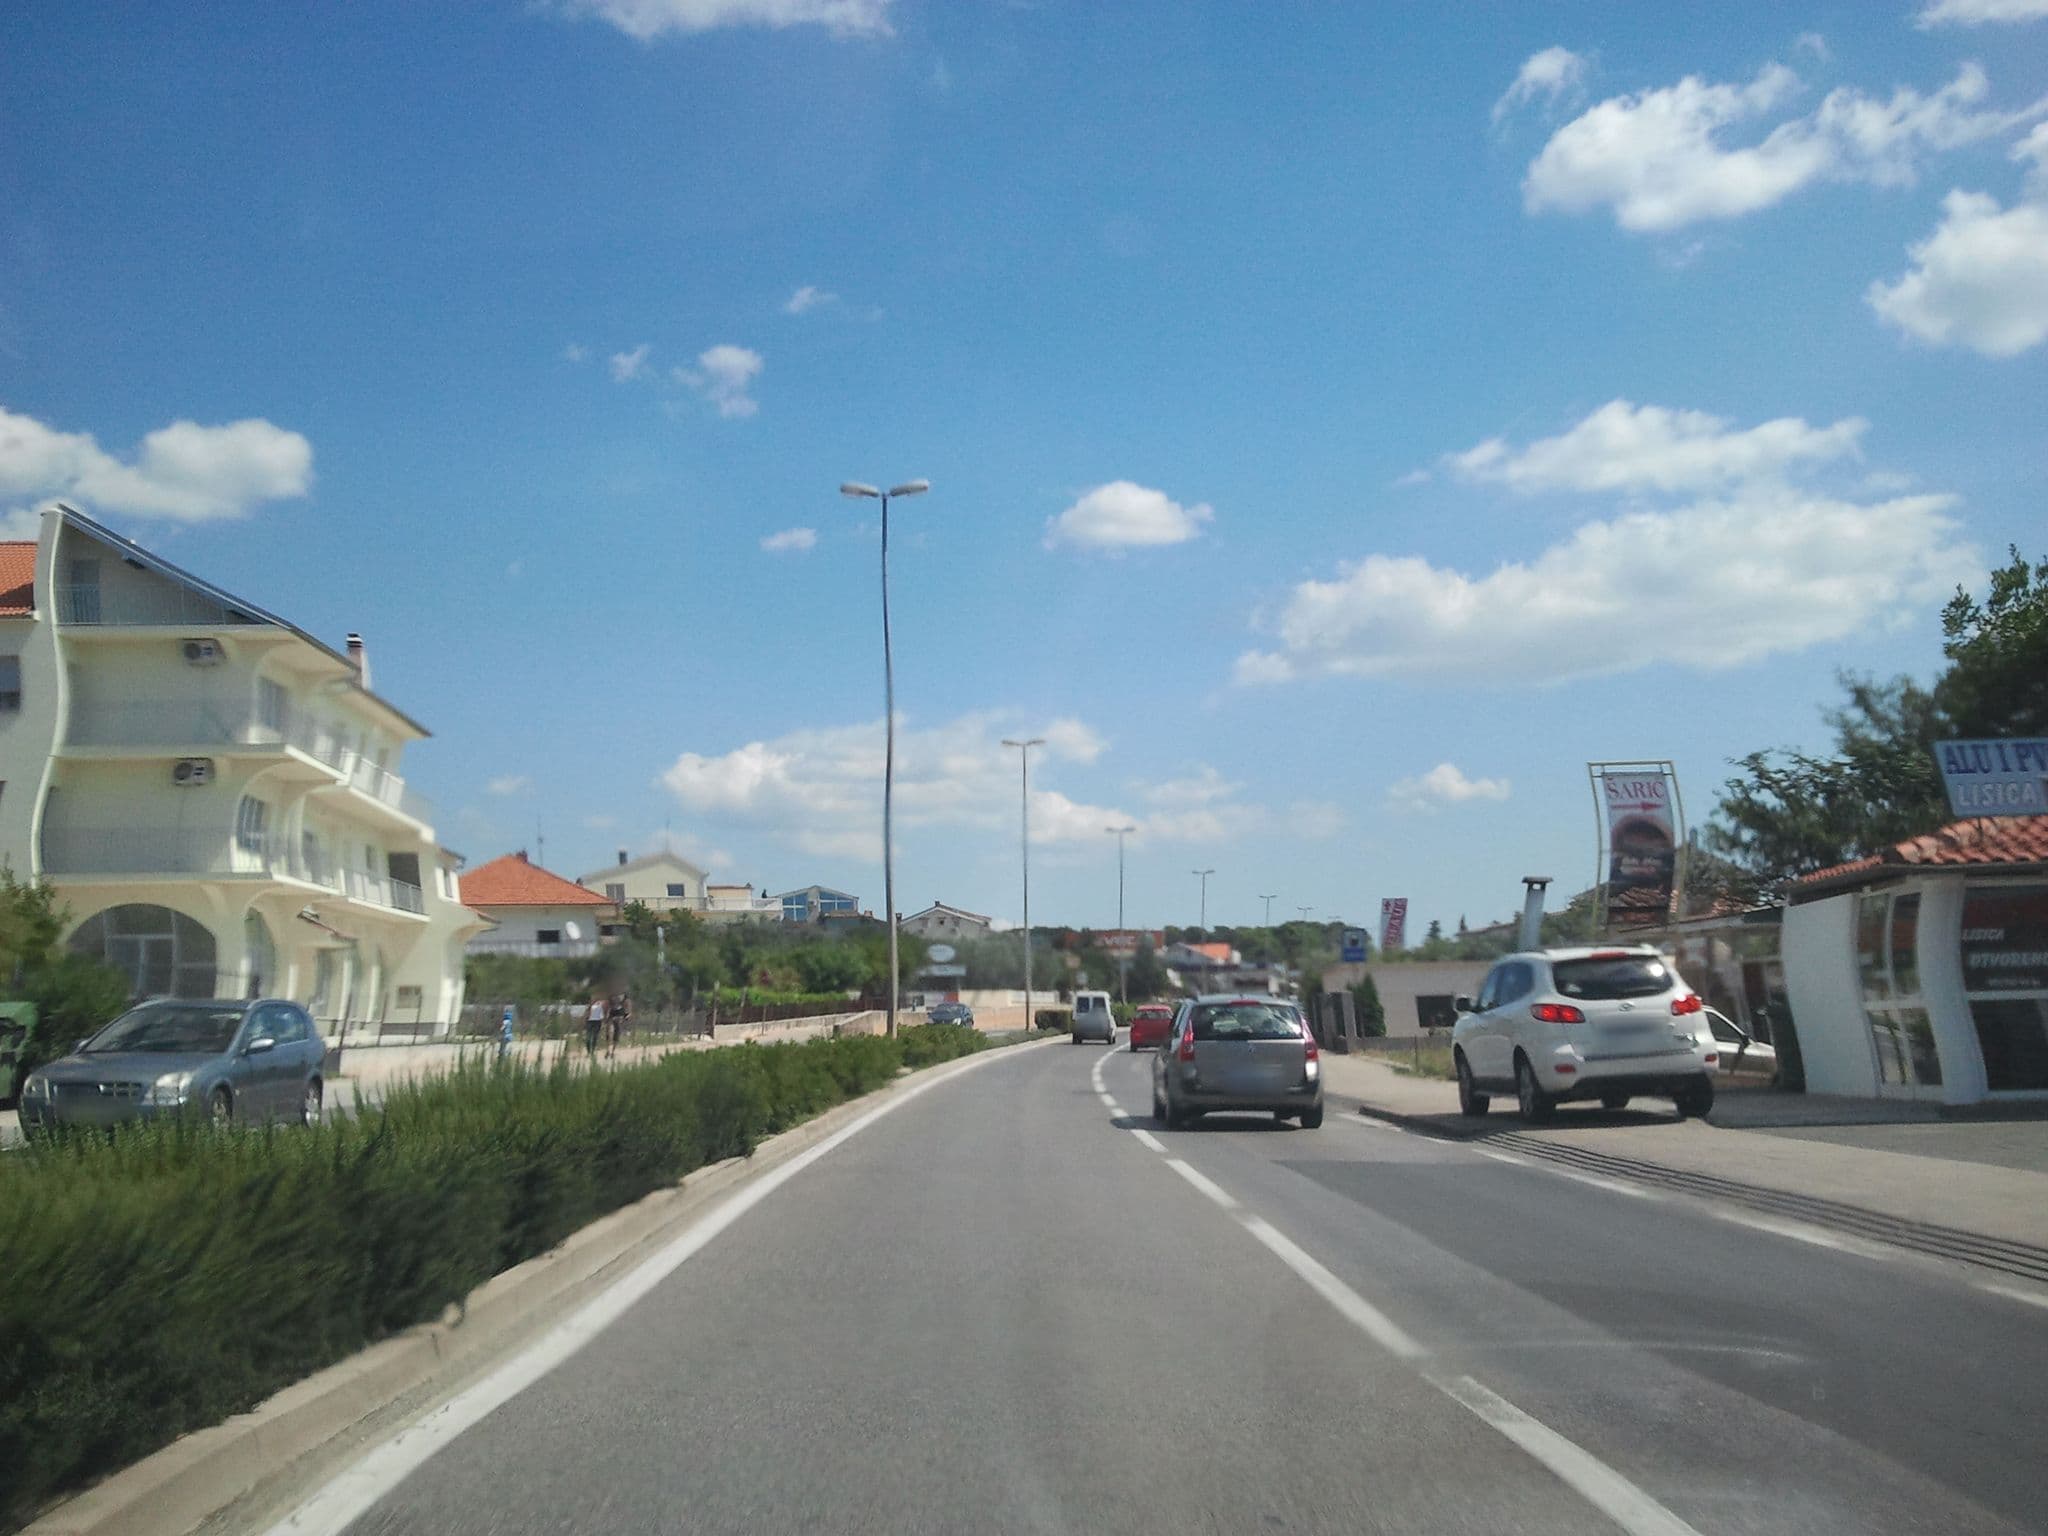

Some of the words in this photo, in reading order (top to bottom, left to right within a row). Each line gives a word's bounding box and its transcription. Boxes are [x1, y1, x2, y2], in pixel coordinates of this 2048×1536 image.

[1945, 744, 1991, 774] ALU
[1996, 743, 2012, 773] I
[1957, 780, 2038, 807] LISICA
